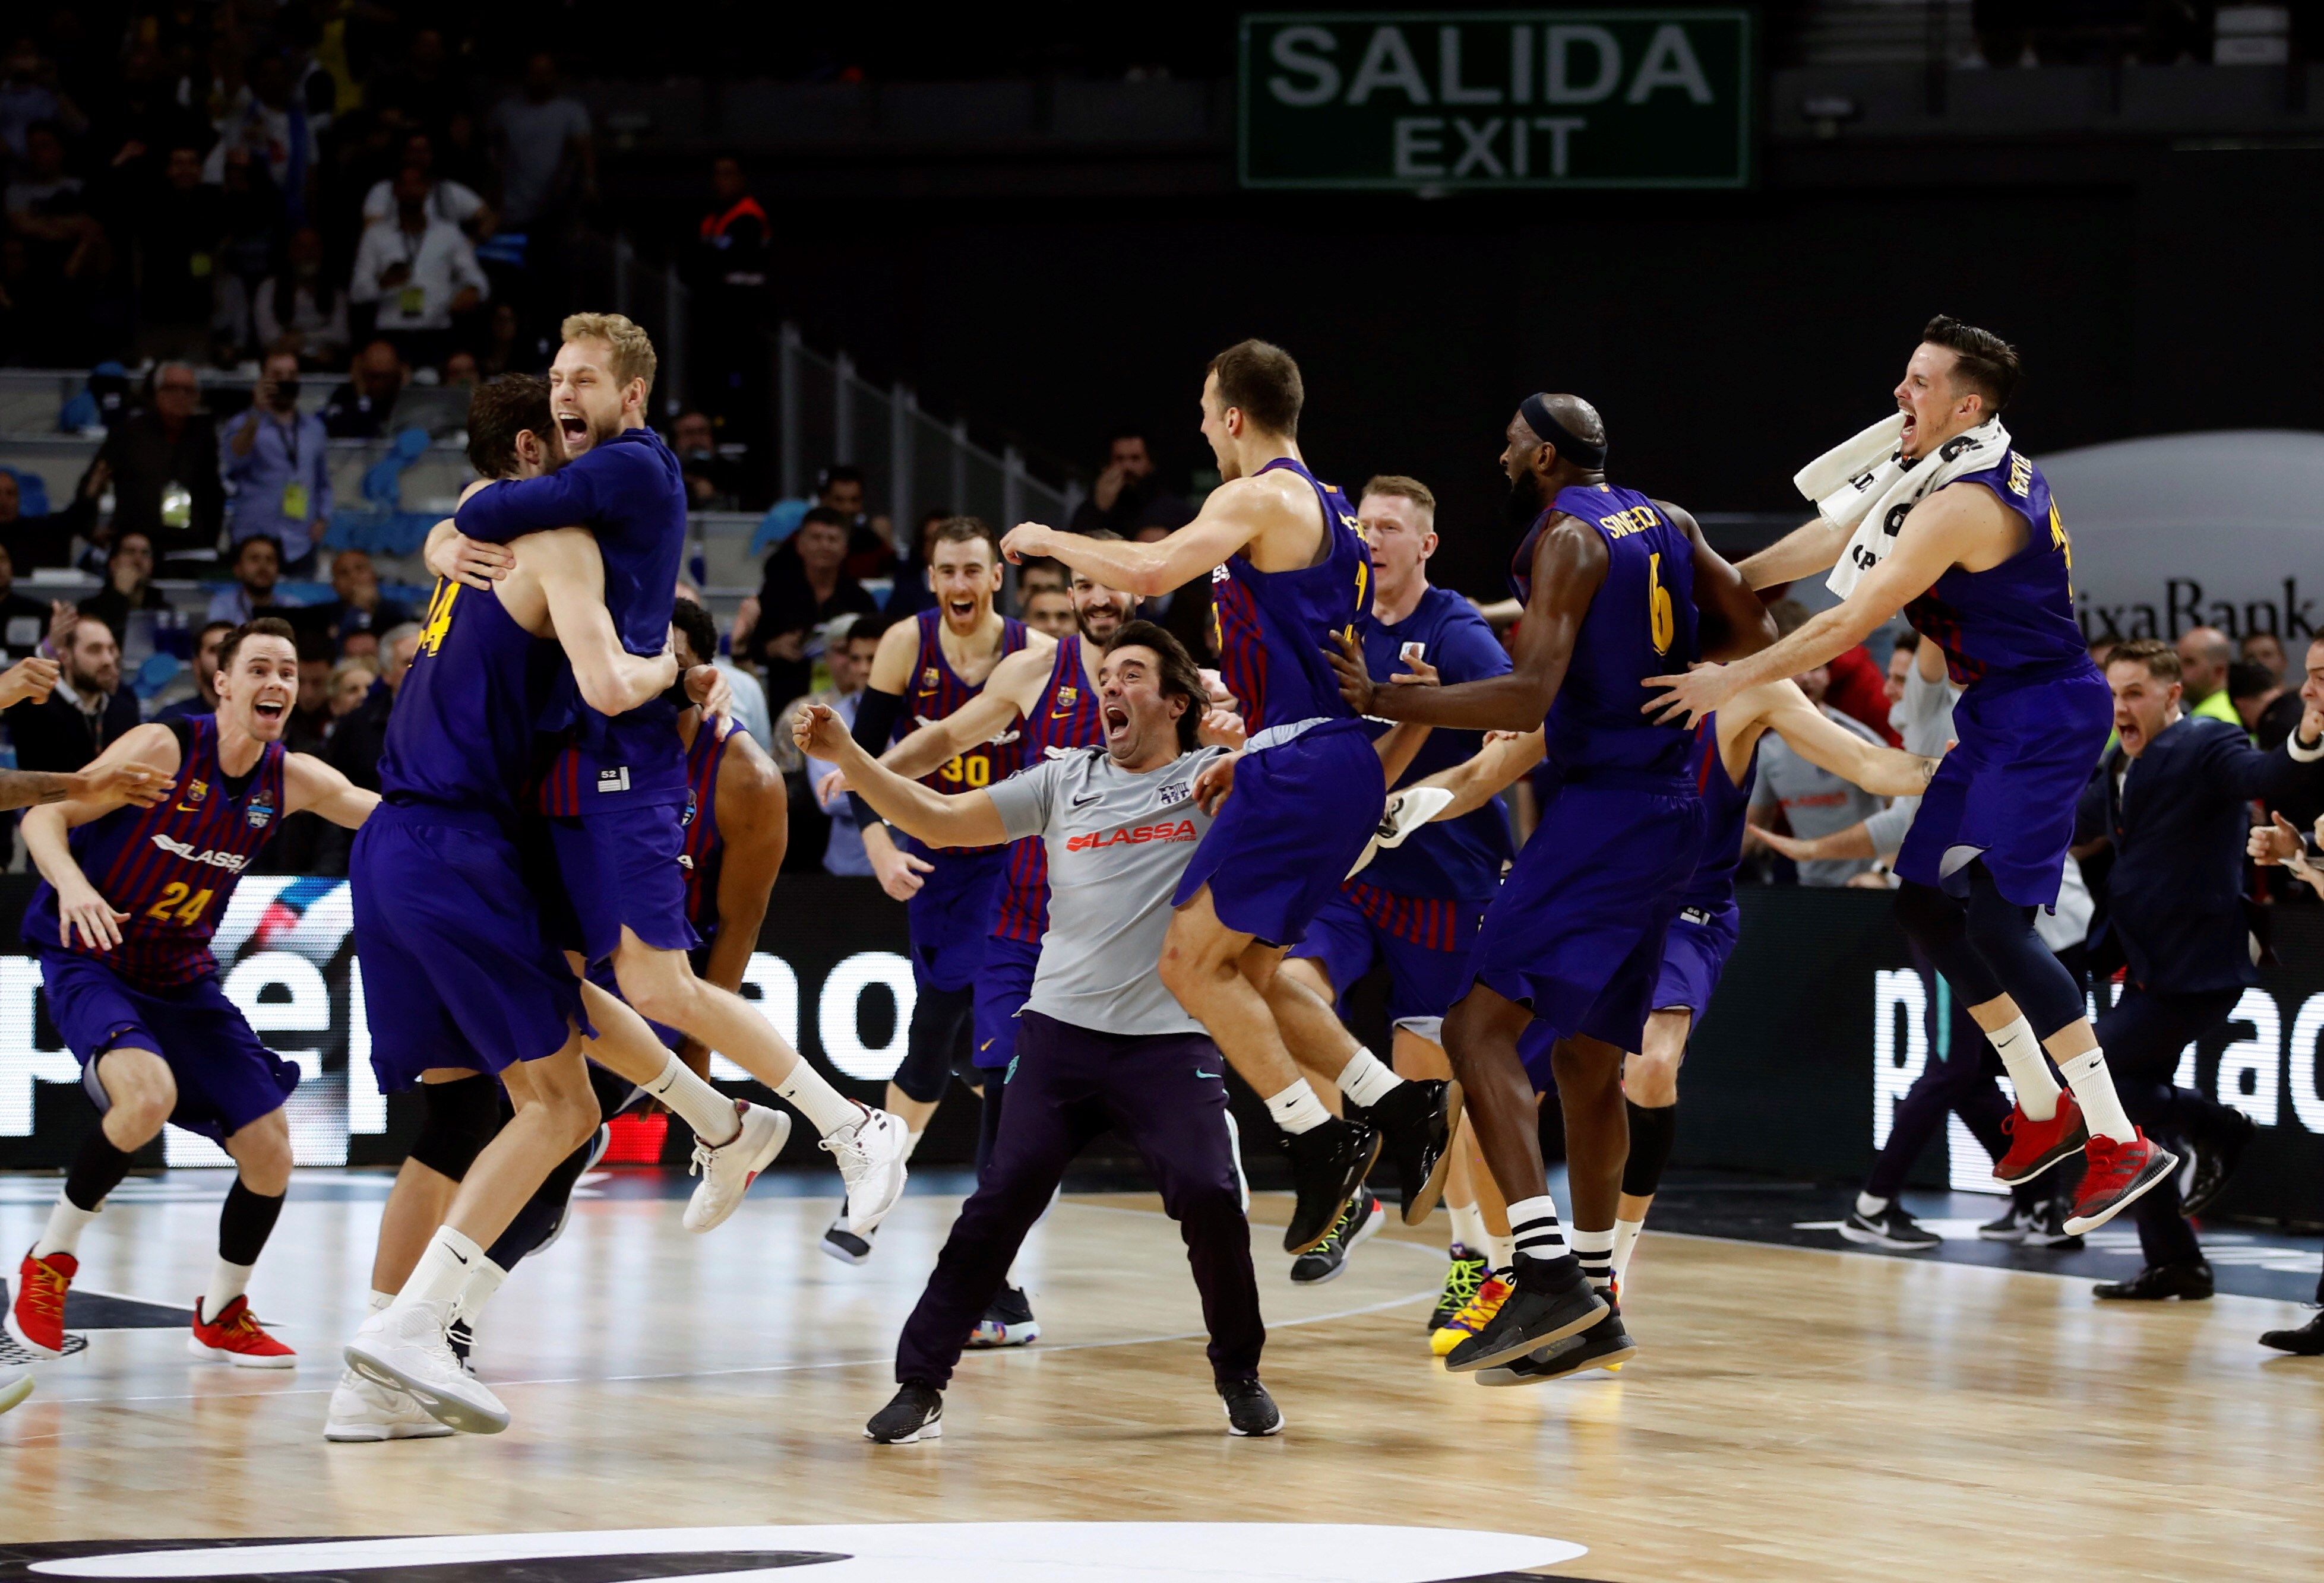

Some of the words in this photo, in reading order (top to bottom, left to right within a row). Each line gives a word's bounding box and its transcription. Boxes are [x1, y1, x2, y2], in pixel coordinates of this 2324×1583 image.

[1267, 24, 1713, 107] SALIDA
[1393, 118, 1587, 178] EXIT
[1649, 552, 1674, 656] 6
[2079, 576, 2314, 643] ixaBank
[601, 770, 617, 778] 52
[940, 755, 990, 788] 30
[1092, 819, 1197, 849] LASSA
[1163, 835, 1196, 844] TYRES
[146, 881, 214, 926] 24
